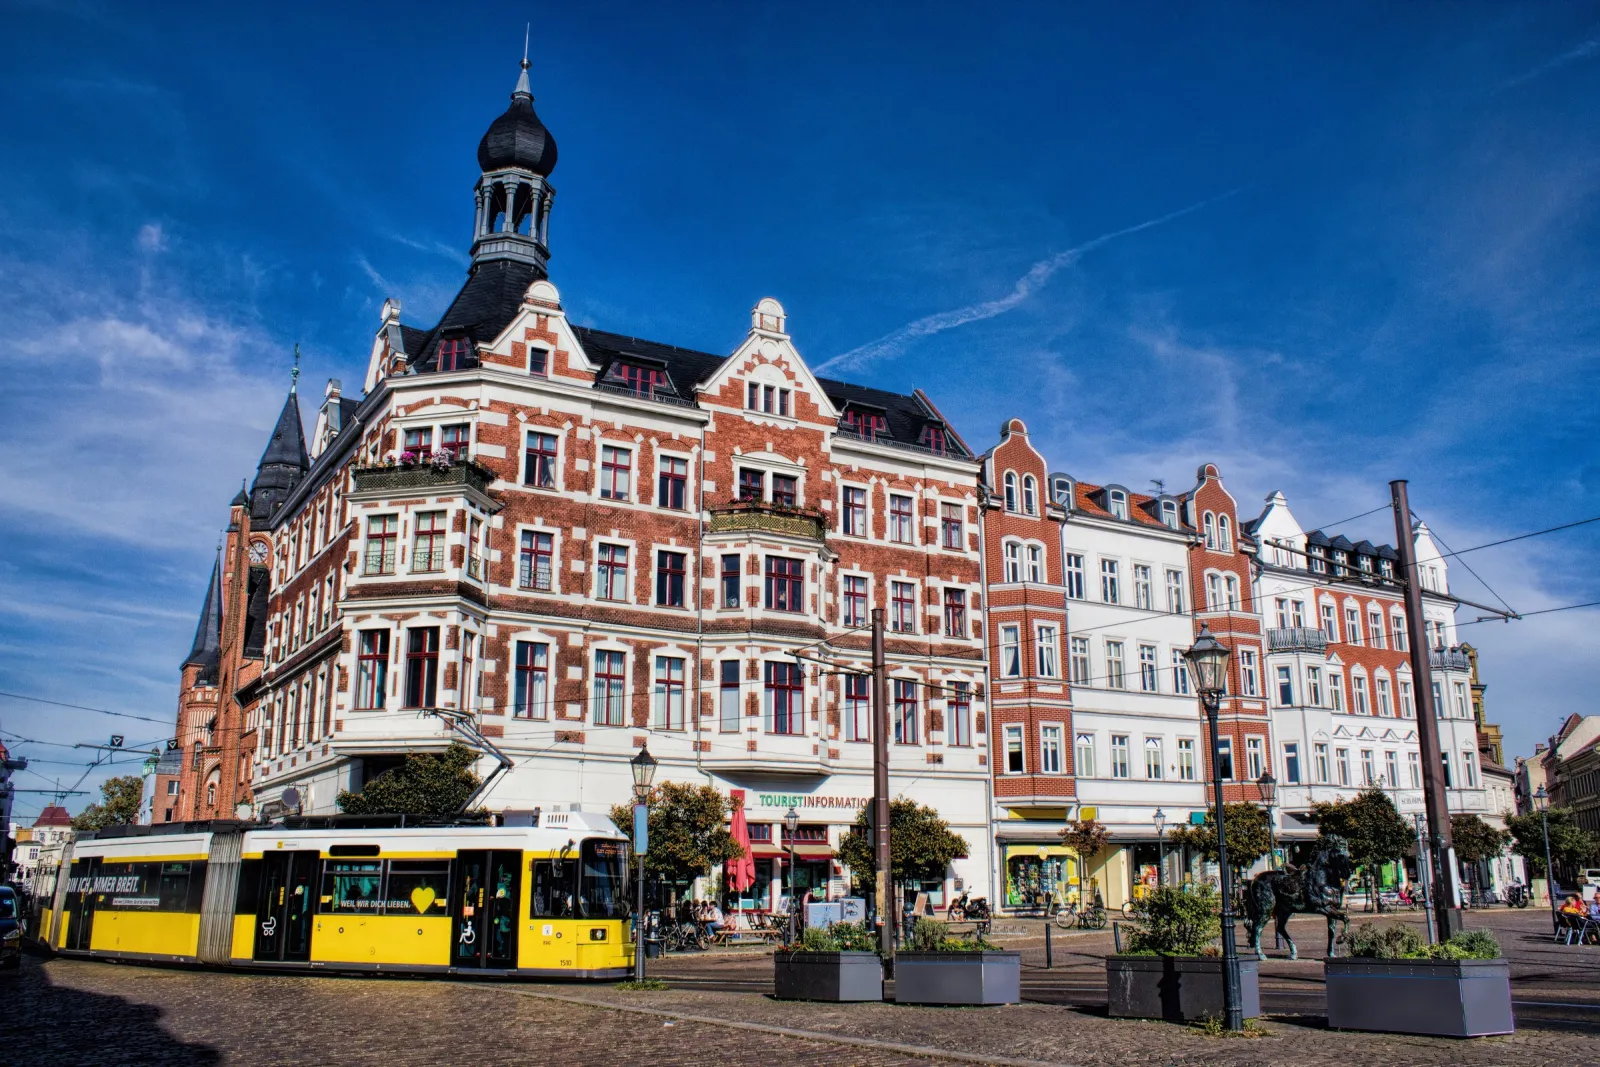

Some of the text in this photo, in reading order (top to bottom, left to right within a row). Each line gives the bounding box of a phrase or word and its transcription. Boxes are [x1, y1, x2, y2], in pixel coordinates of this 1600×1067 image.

[759, 795, 870, 809] TOURISTINFORMATIO
[77, 877, 92, 893] ICH
[115, 876, 139, 893] BREIT.
[341, 900, 411, 908] WEIL WIR DICH LIEBEN.
